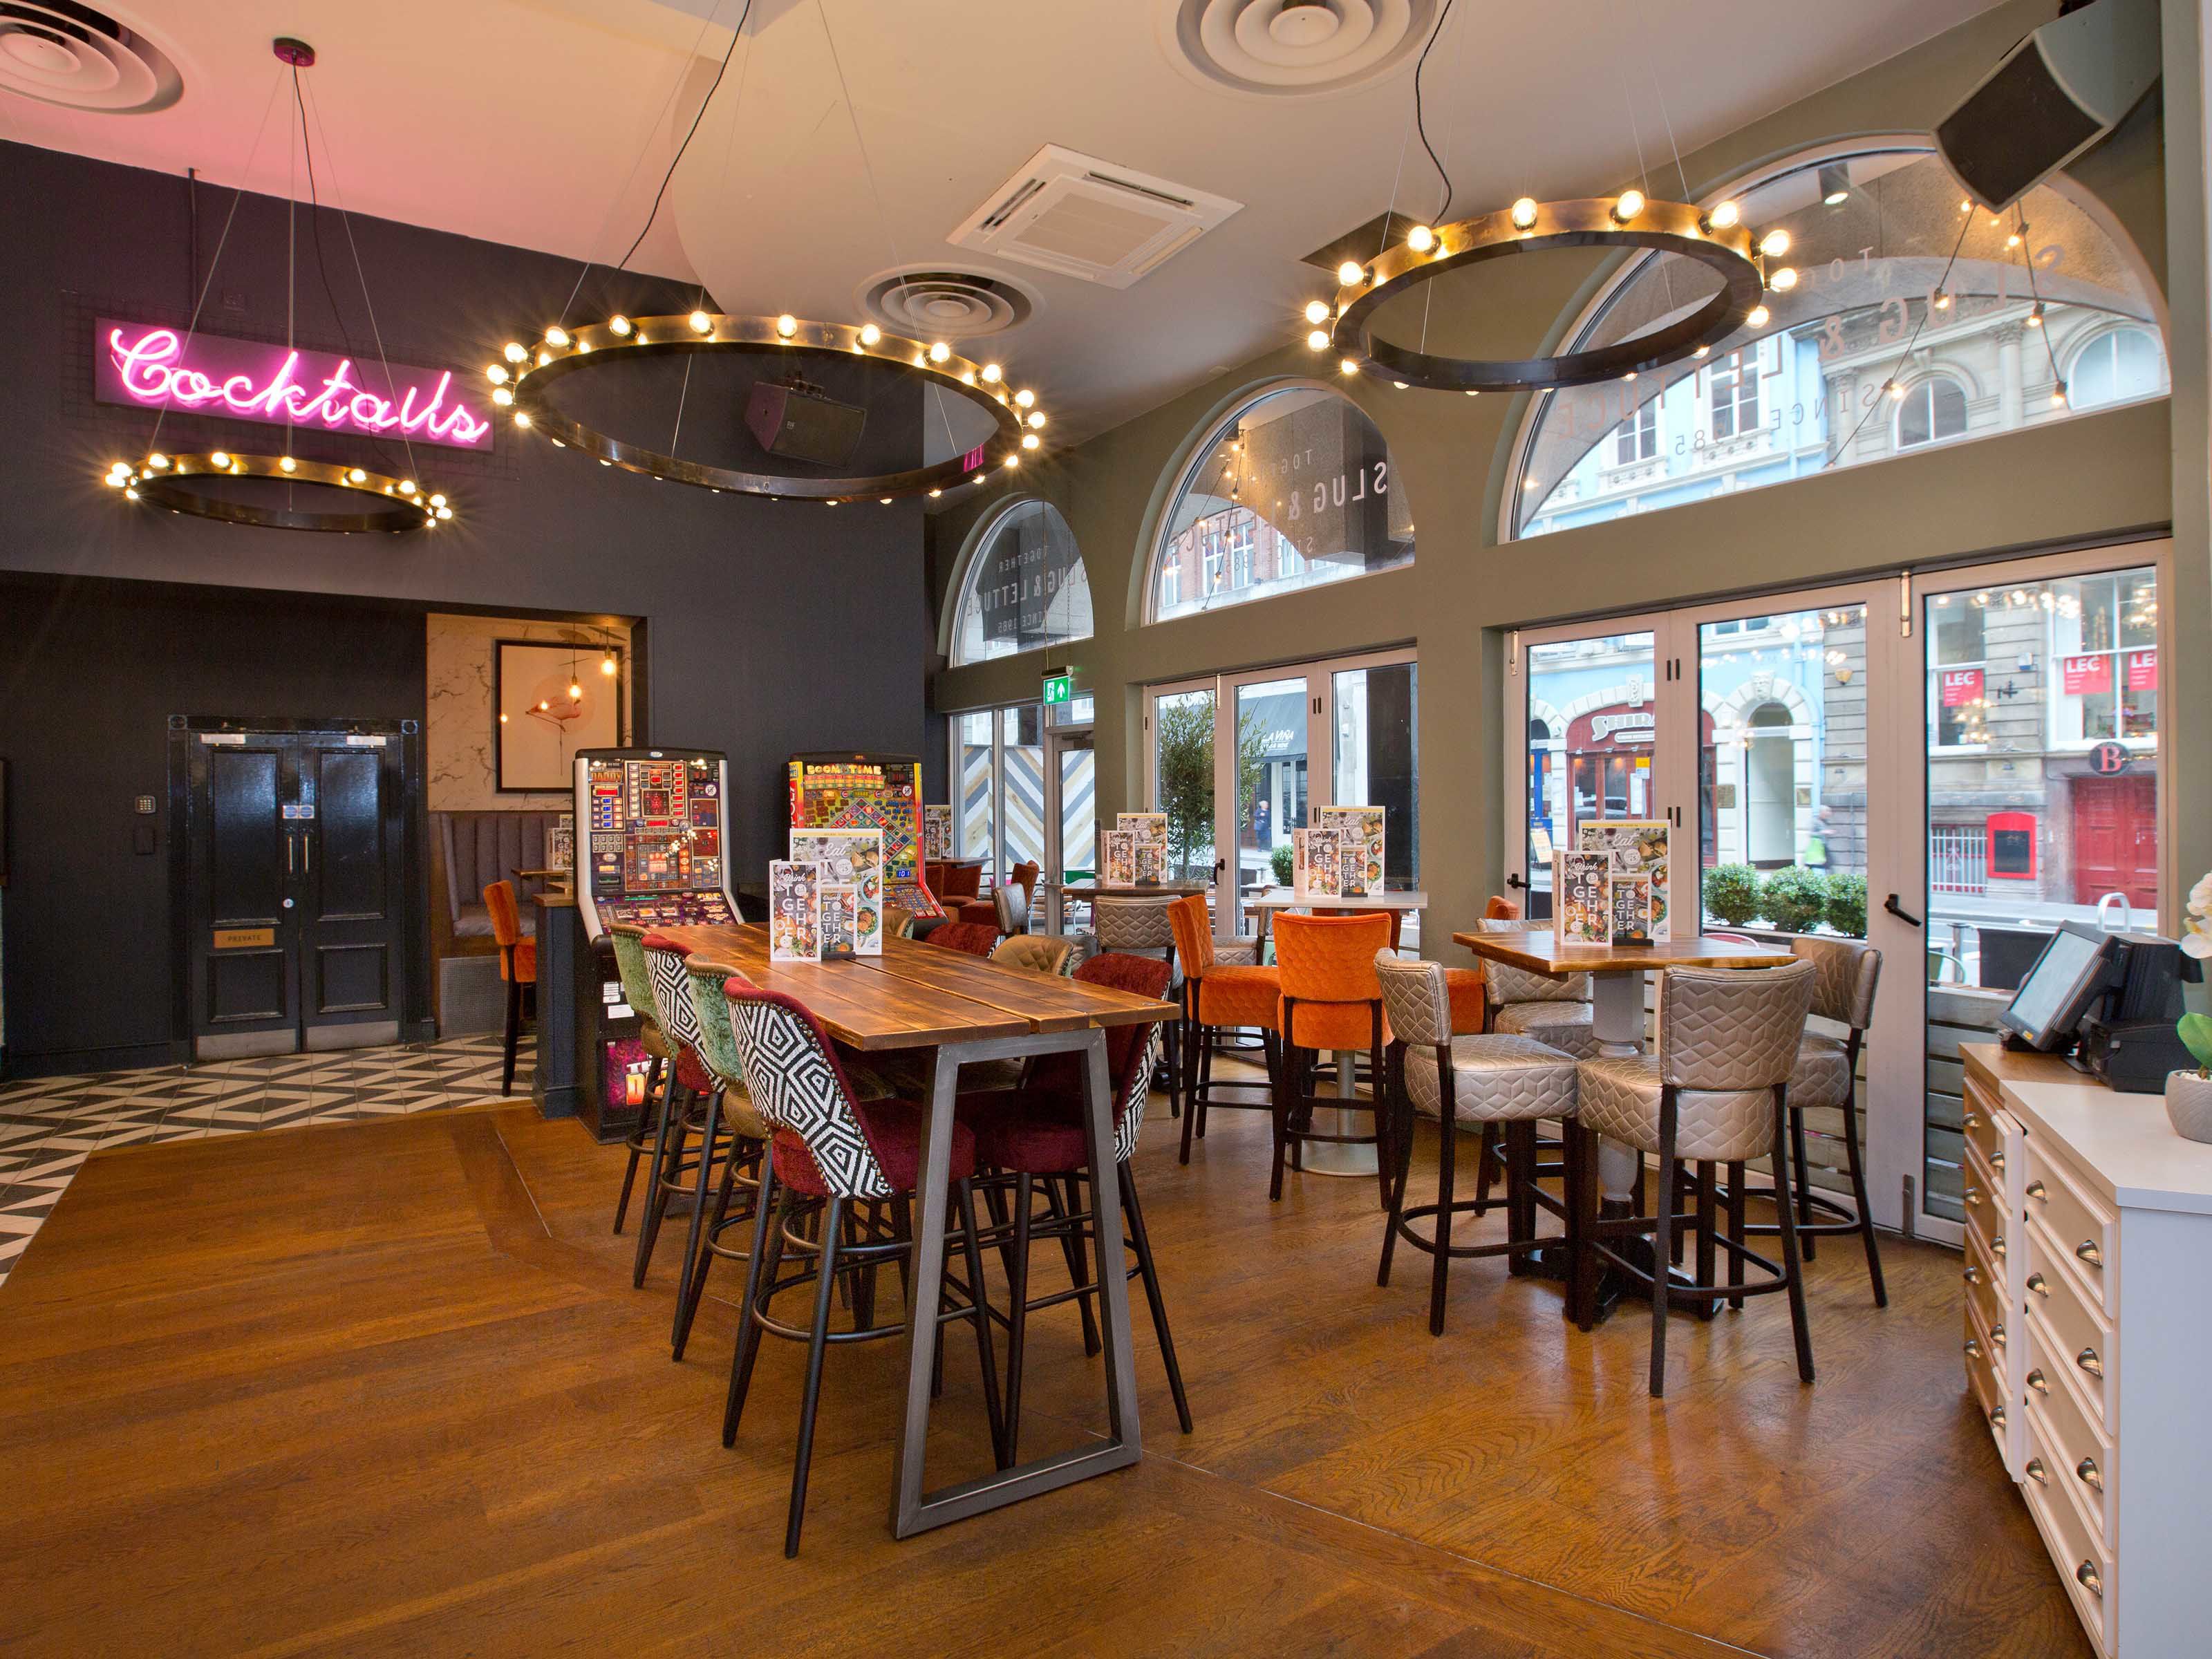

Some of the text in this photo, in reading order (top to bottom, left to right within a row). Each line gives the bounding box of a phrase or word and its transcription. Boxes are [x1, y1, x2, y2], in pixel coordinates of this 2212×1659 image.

[110, 327, 489, 443] Cocktails
[2066, 657, 2101, 673] LEC
[2130, 653, 2157, 668] LE
[1945, 672, 1975, 686] LEC
[1591, 713, 1654, 742] SHIR
[2099, 746, 2123, 772] B
[591, 771, 622, 782] DADDY
[807, 765, 841, 775] BOOM
[848, 765, 881, 776] TIME
[1613, 834, 1639, 847] Eat
[825, 842, 852, 856] Eat
[1315, 854, 1331, 863] GE
[1573, 886, 1597, 898] GE
[782, 899, 805, 910] GE
[1574, 900, 1597, 912] TH
[1616, 900, 1635, 909] GE
[783, 912, 807, 925] TH
[823, 912, 841, 921] GE
[1575, 913, 1598, 926] ER
[1616, 910, 1635, 919] TH
[823, 923, 841, 932] TH
[1618, 921, 1635, 930] ER
[785, 927, 807, 940] ER
[823, 933, 841, 943] ER
